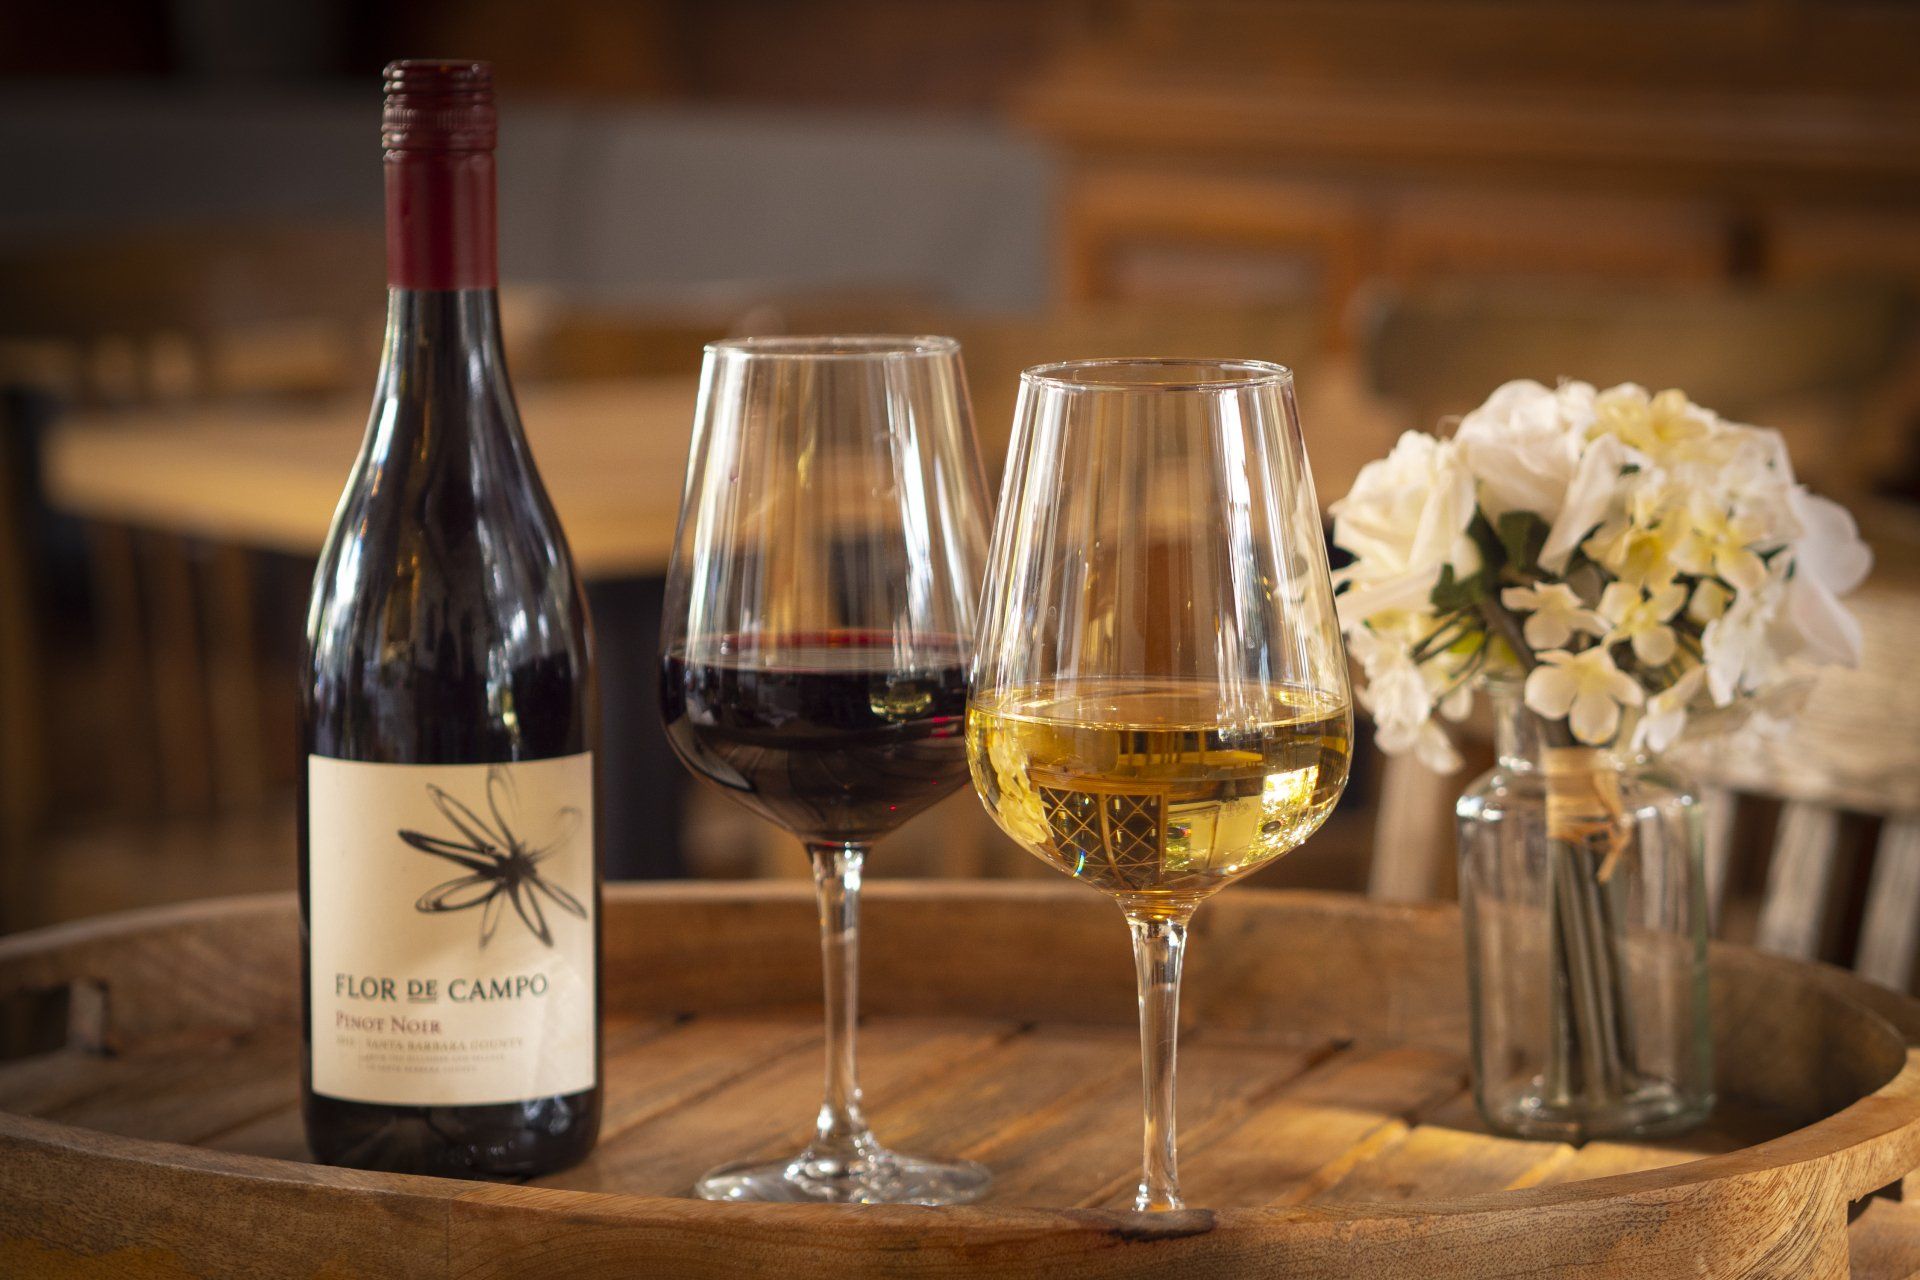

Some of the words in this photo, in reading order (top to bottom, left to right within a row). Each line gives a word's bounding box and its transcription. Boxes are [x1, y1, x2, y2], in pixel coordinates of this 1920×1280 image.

[335, 973, 397, 1001] FLOR
[407, 979, 438, 1002] DE
[448, 973, 548, 1002] CAMPO
